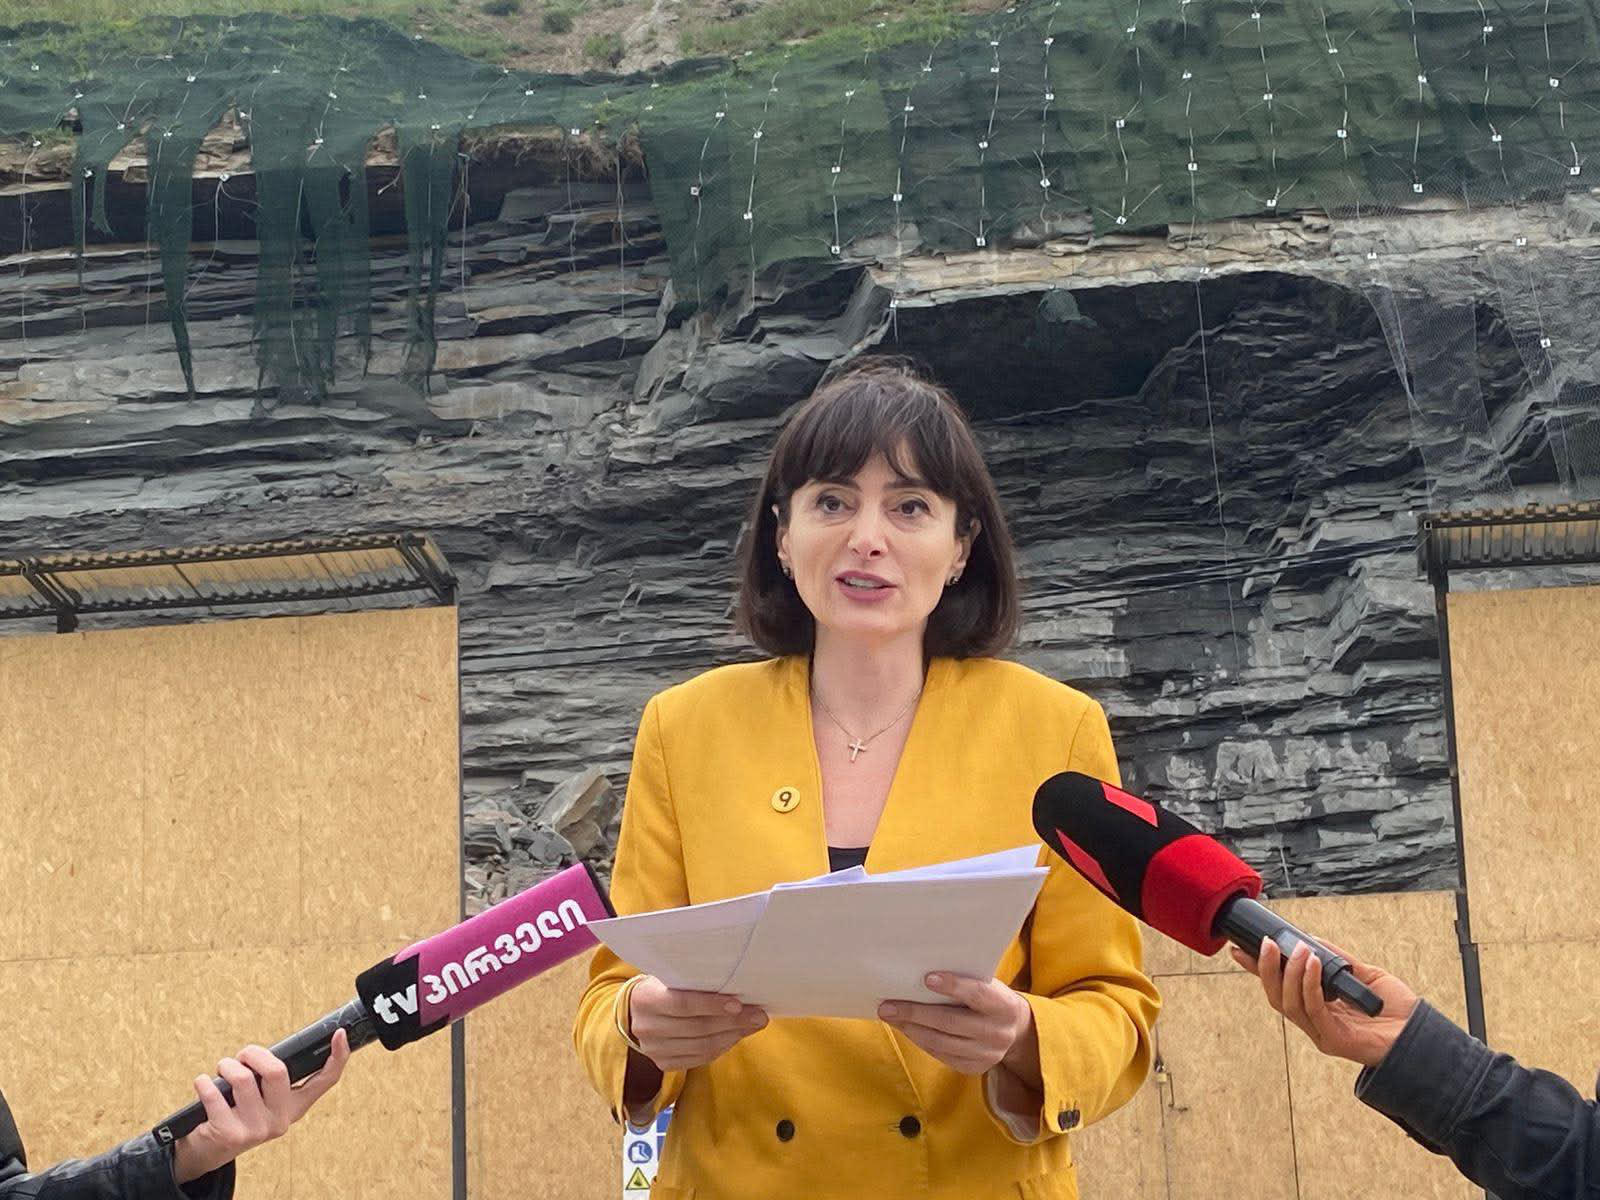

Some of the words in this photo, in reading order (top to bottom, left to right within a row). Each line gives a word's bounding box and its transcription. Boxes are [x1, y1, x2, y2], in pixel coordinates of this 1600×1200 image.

[779, 791, 792, 807] 9
[373, 984, 417, 1024] tv
[422, 899, 587, 1005] პირველი
